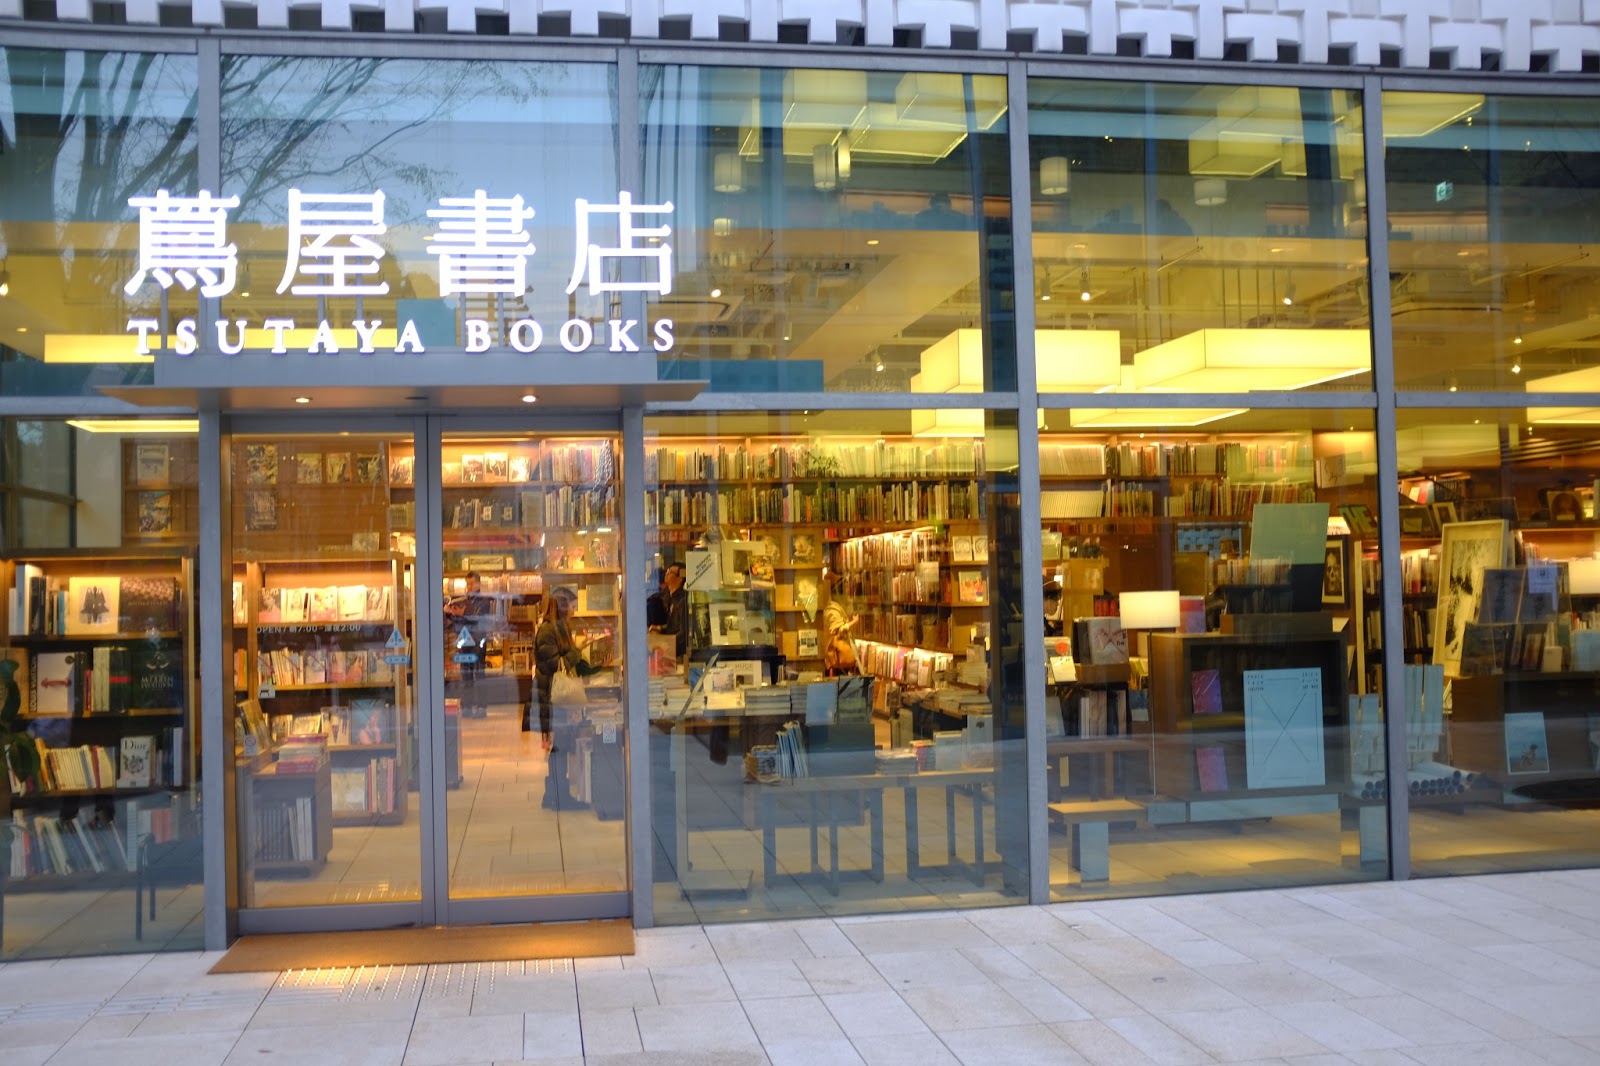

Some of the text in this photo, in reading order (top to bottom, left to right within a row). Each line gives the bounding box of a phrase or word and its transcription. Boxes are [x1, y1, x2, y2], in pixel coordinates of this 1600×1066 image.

[124, 188, 675, 298] 蔦屋書店
[126, 318, 675, 355] TSUTAYA BOOKS
[255, 626, 282, 634] OPEN
[124, 740, 147, 750] Dior
